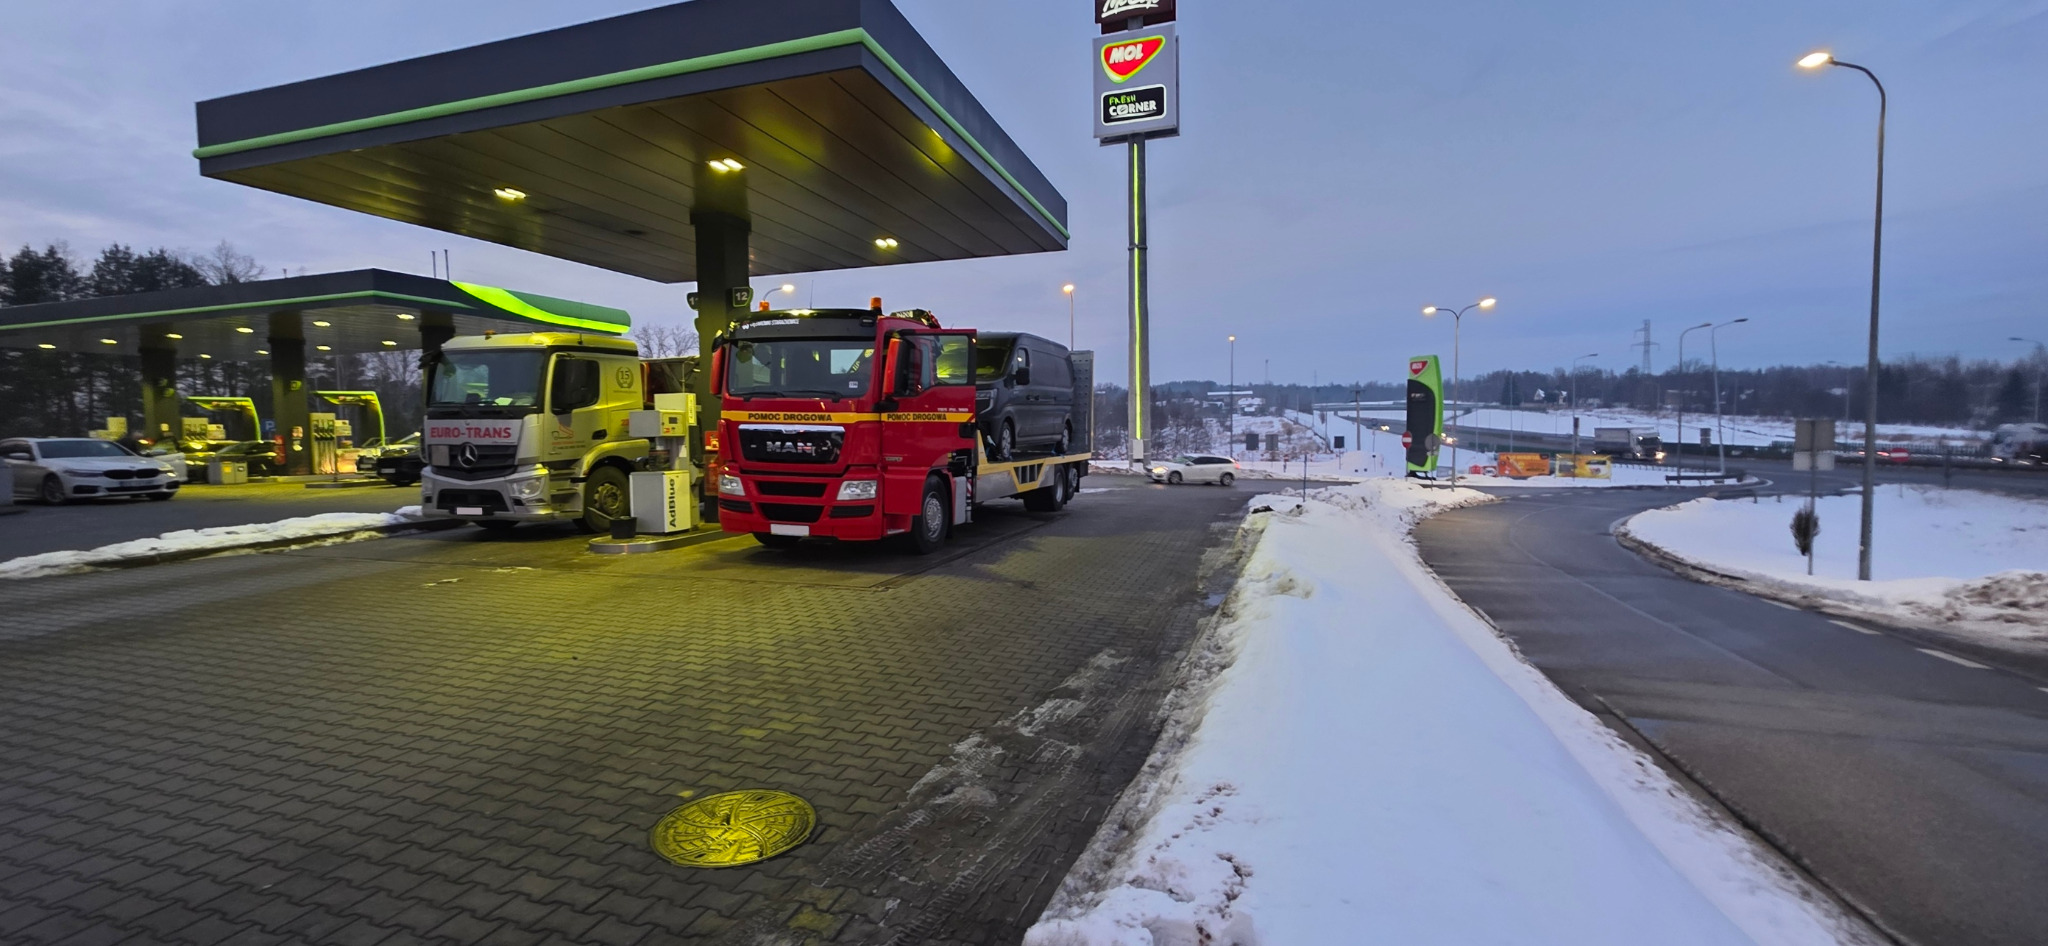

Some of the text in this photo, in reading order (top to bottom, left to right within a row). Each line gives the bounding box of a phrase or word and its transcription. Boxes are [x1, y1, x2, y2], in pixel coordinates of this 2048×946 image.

[1109, 43, 1143, 64] MOL
[1109, 100, 1157, 116] CORNER
[735, 291, 748, 301] 12
[619, 370, 630, 380] 15
[748, 412, 833, 421] POMOC DROGOWA
[887, 413, 947, 421] POMOC DROGOWA
[430, 427, 512, 439] EURO-TRANS
[766, 441, 813, 453] MAN
[668, 478, 676, 528] AdBlue
